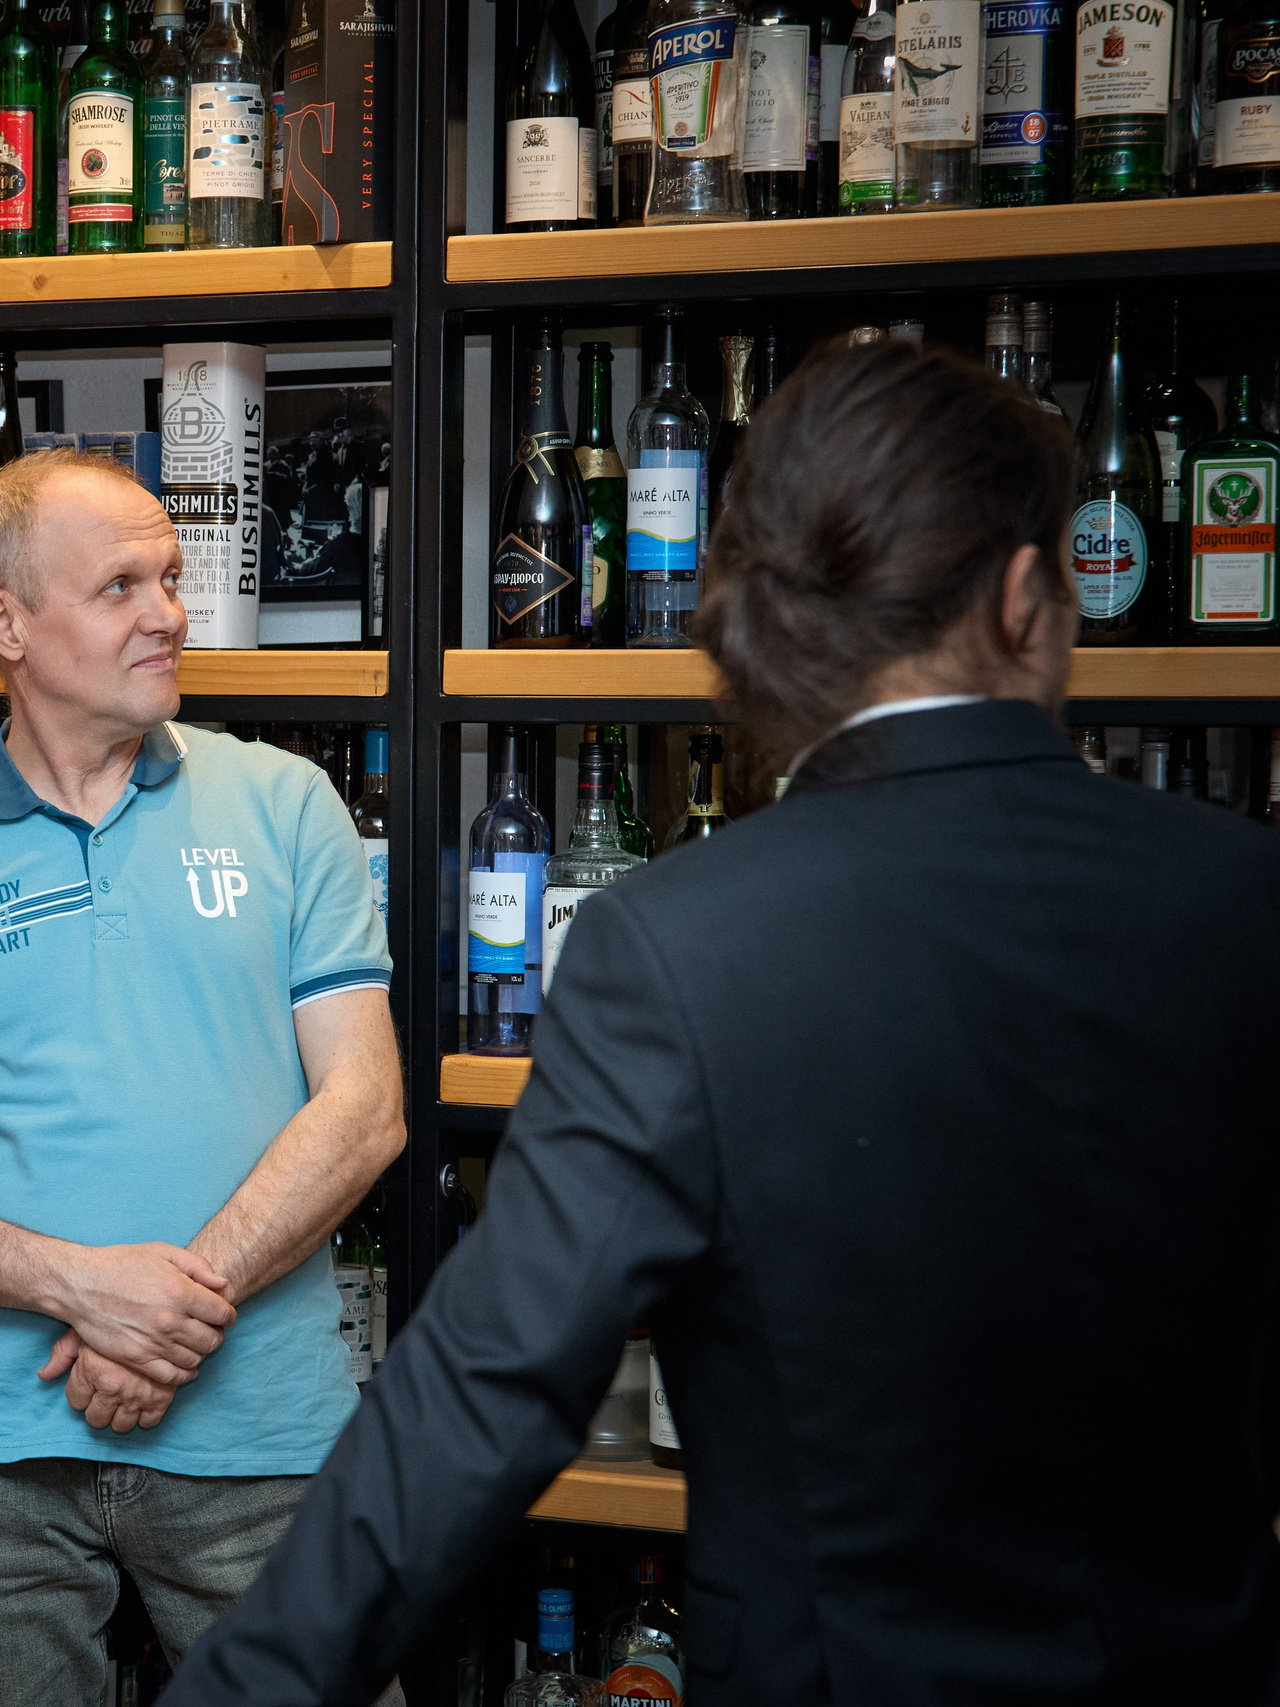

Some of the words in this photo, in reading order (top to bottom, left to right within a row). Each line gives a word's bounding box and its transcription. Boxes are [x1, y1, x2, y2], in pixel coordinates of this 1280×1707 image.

[986, 8, 1061, 28] HEROVKA
[1078, 4, 1163, 35] JAMESON
[339, 21, 395, 32] SARAJISHVIL
[652, 29, 725, 69] APEROL
[897, 36, 962, 53] STELARIS
[667, 80, 700, 94] APERITIVO
[750, 89, 772, 97] NOT
[363, 61, 374, 147] SPECIAL
[747, 99, 775, 107] IGIO
[71, 105, 127, 125] SHAMROSE
[618, 111, 651, 121] CHIAN
[849, 110, 890, 123] VALJEAN
[1241, 105, 1272, 115] RUBY
[150, 123, 172, 131] DELLE
[202, 120, 260, 130] PIETRAME
[1029, 118, 1040, 126] 18
[1028, 129, 1040, 138] 07
[516, 155, 556, 163] SANCERRE
[362, 159, 373, 209] VERY
[179, 407, 203, 439] B
[239, 404, 261, 596] BUSHMILLS
[629, 487, 657, 502] MARÉ
[662, 490, 691, 502] ALTA
[181, 546, 202, 556] ATURE
[1073, 534, 1130, 555] Cidre
[198, 558, 213, 569] AND
[1086, 563, 1118, 571] ROYAL
[224, 571, 230, 581] A
[181, 848, 245, 867] LEVEL
[186, 867, 249, 919] UP
[489, 894, 517, 906] ALTA
[548, 904, 574, 930] JIM
